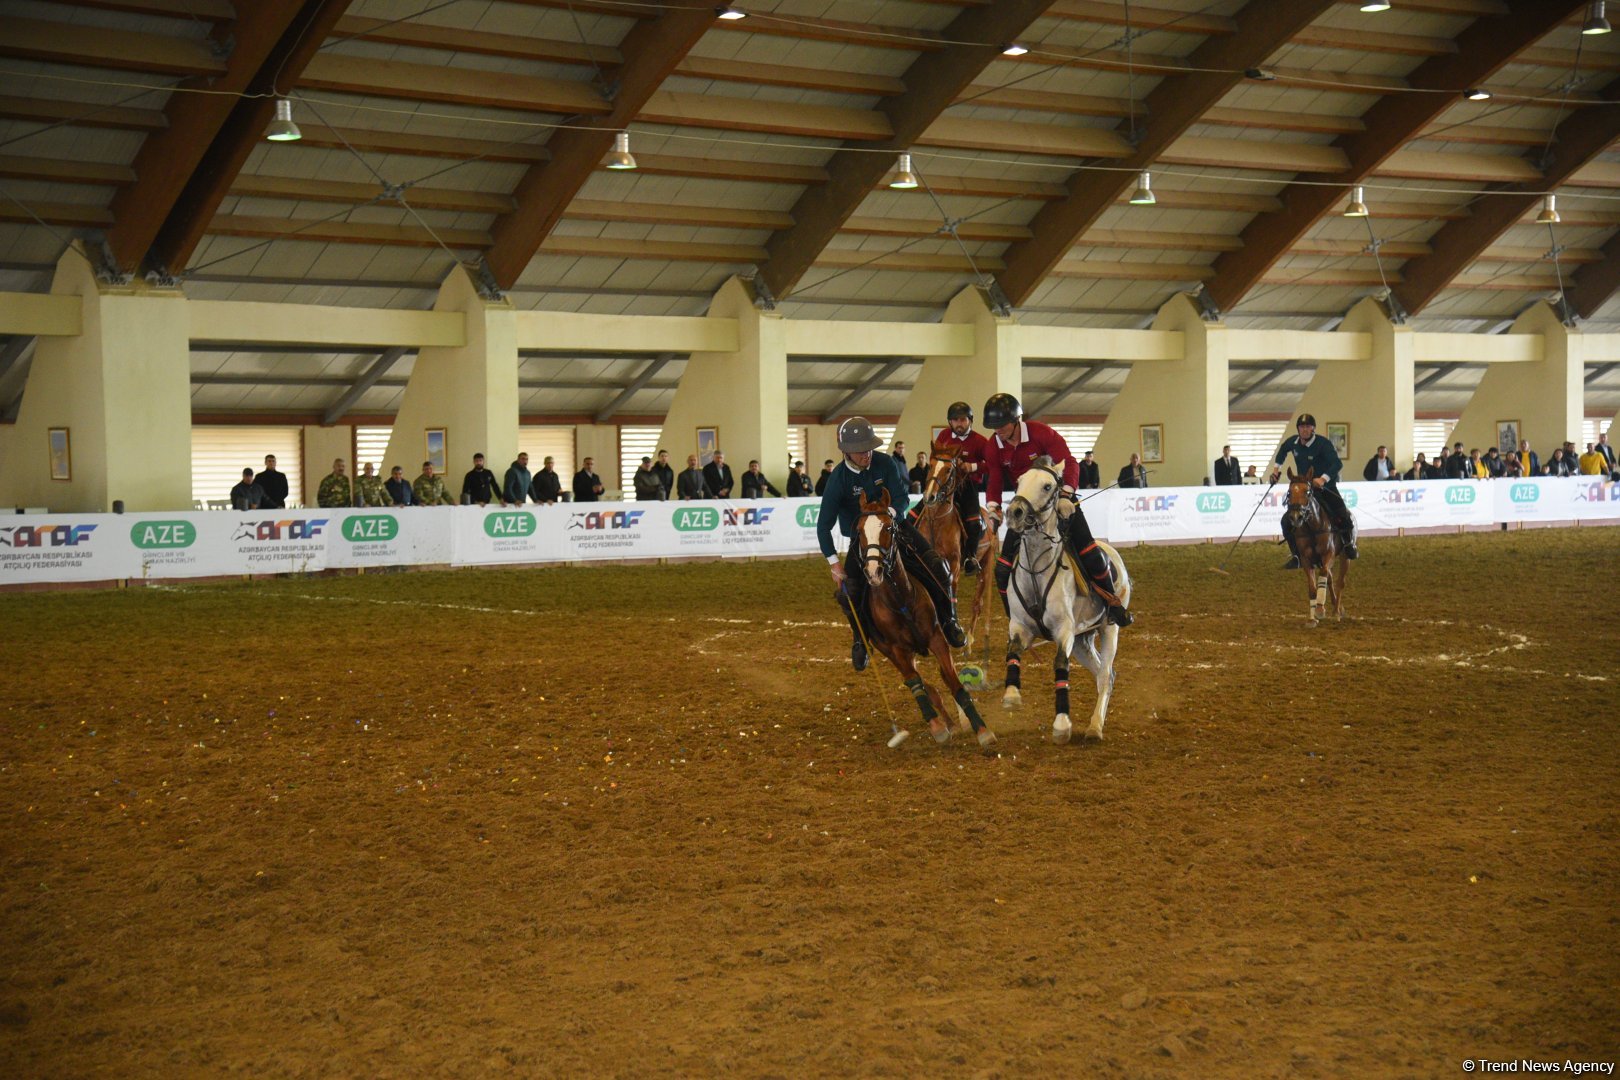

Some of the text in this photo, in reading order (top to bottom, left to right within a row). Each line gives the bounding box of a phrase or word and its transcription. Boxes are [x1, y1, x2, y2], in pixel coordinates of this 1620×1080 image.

[1450, 488, 1471, 502] AZE
[1514, 486, 1535, 500] AZE
[1202, 495, 1225, 510] AZE
[680, 511, 712, 528] AZE
[803, 508, 820, 524] AZ
[351, 519, 389, 538] AZE
[493, 516, 528, 533] AZE
[142, 525, 185, 545] AZE
